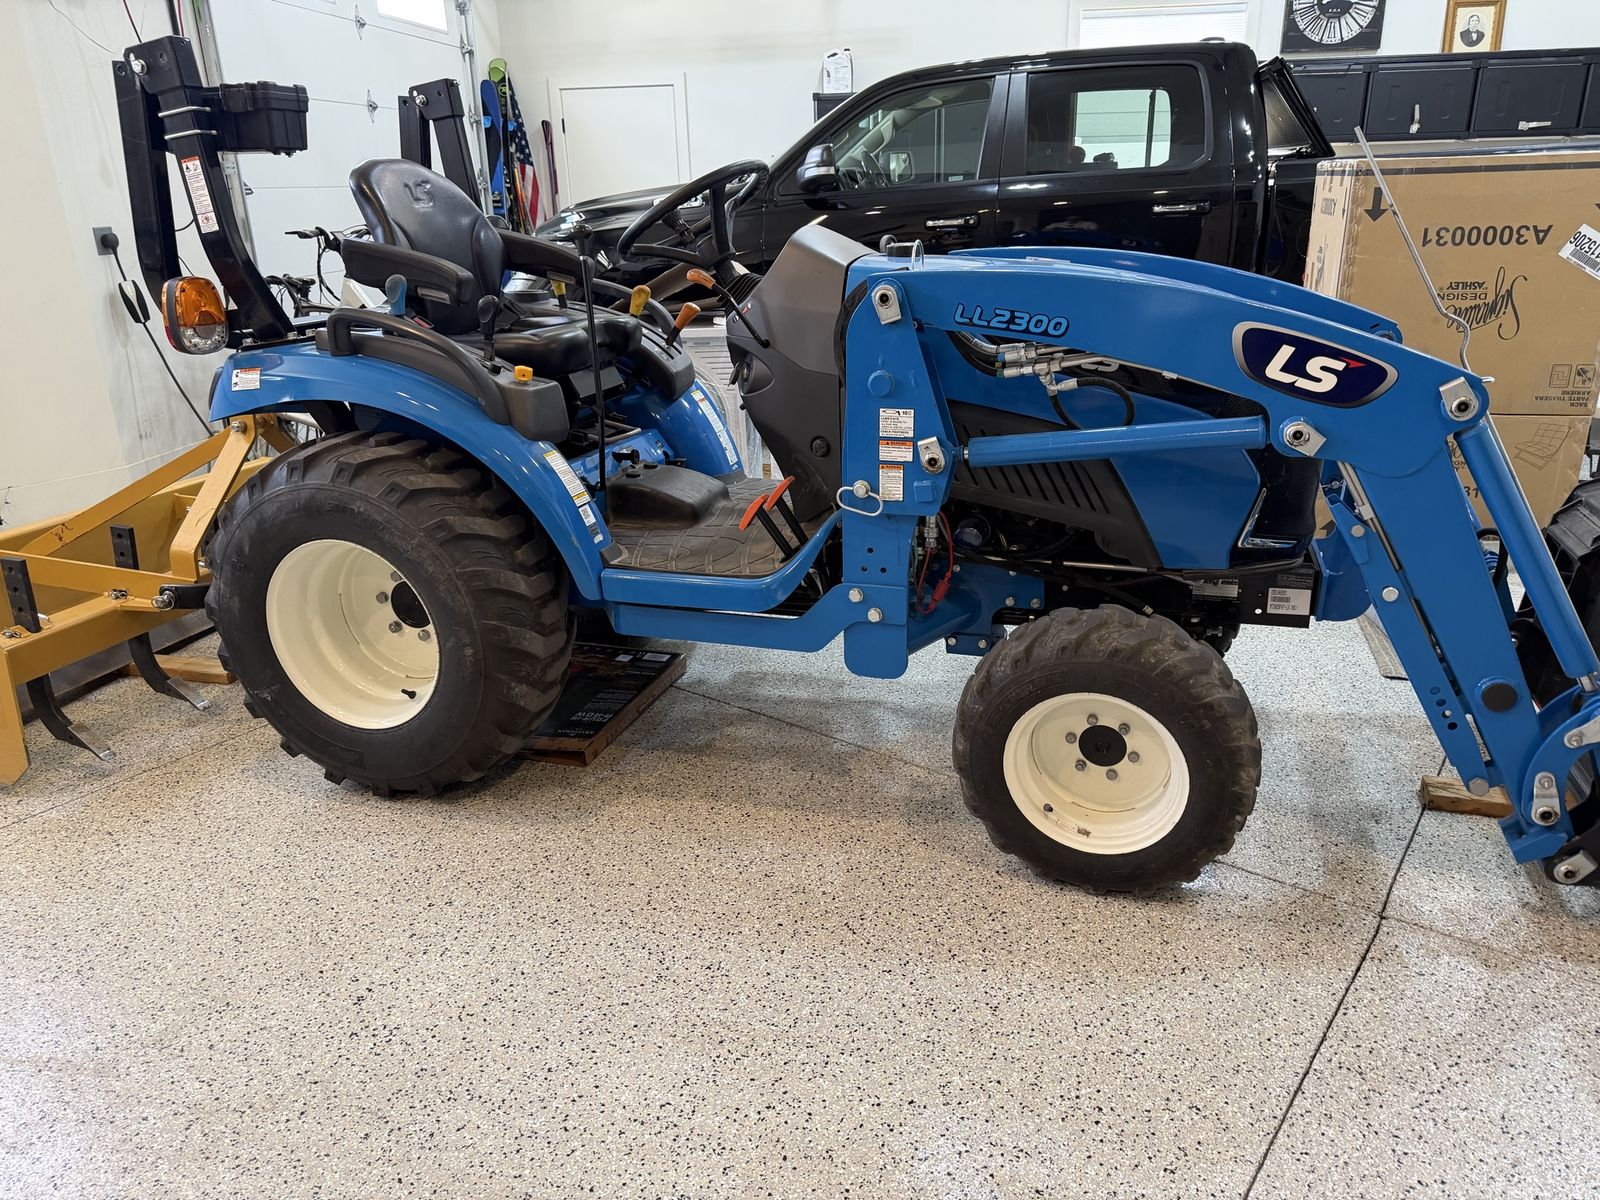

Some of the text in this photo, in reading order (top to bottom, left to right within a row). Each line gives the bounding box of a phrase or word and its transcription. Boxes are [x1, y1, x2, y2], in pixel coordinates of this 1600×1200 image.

[1421, 224, 1553, 247] A3000031
[1437, 292, 1488, 301] DESIGN
[1446, 281, 1486, 291] ASHLEY
[1445, 266, 1528, 340] Signature
[953, 303, 1069, 337] LL2300
[1265, 344, 1347, 393] LS
